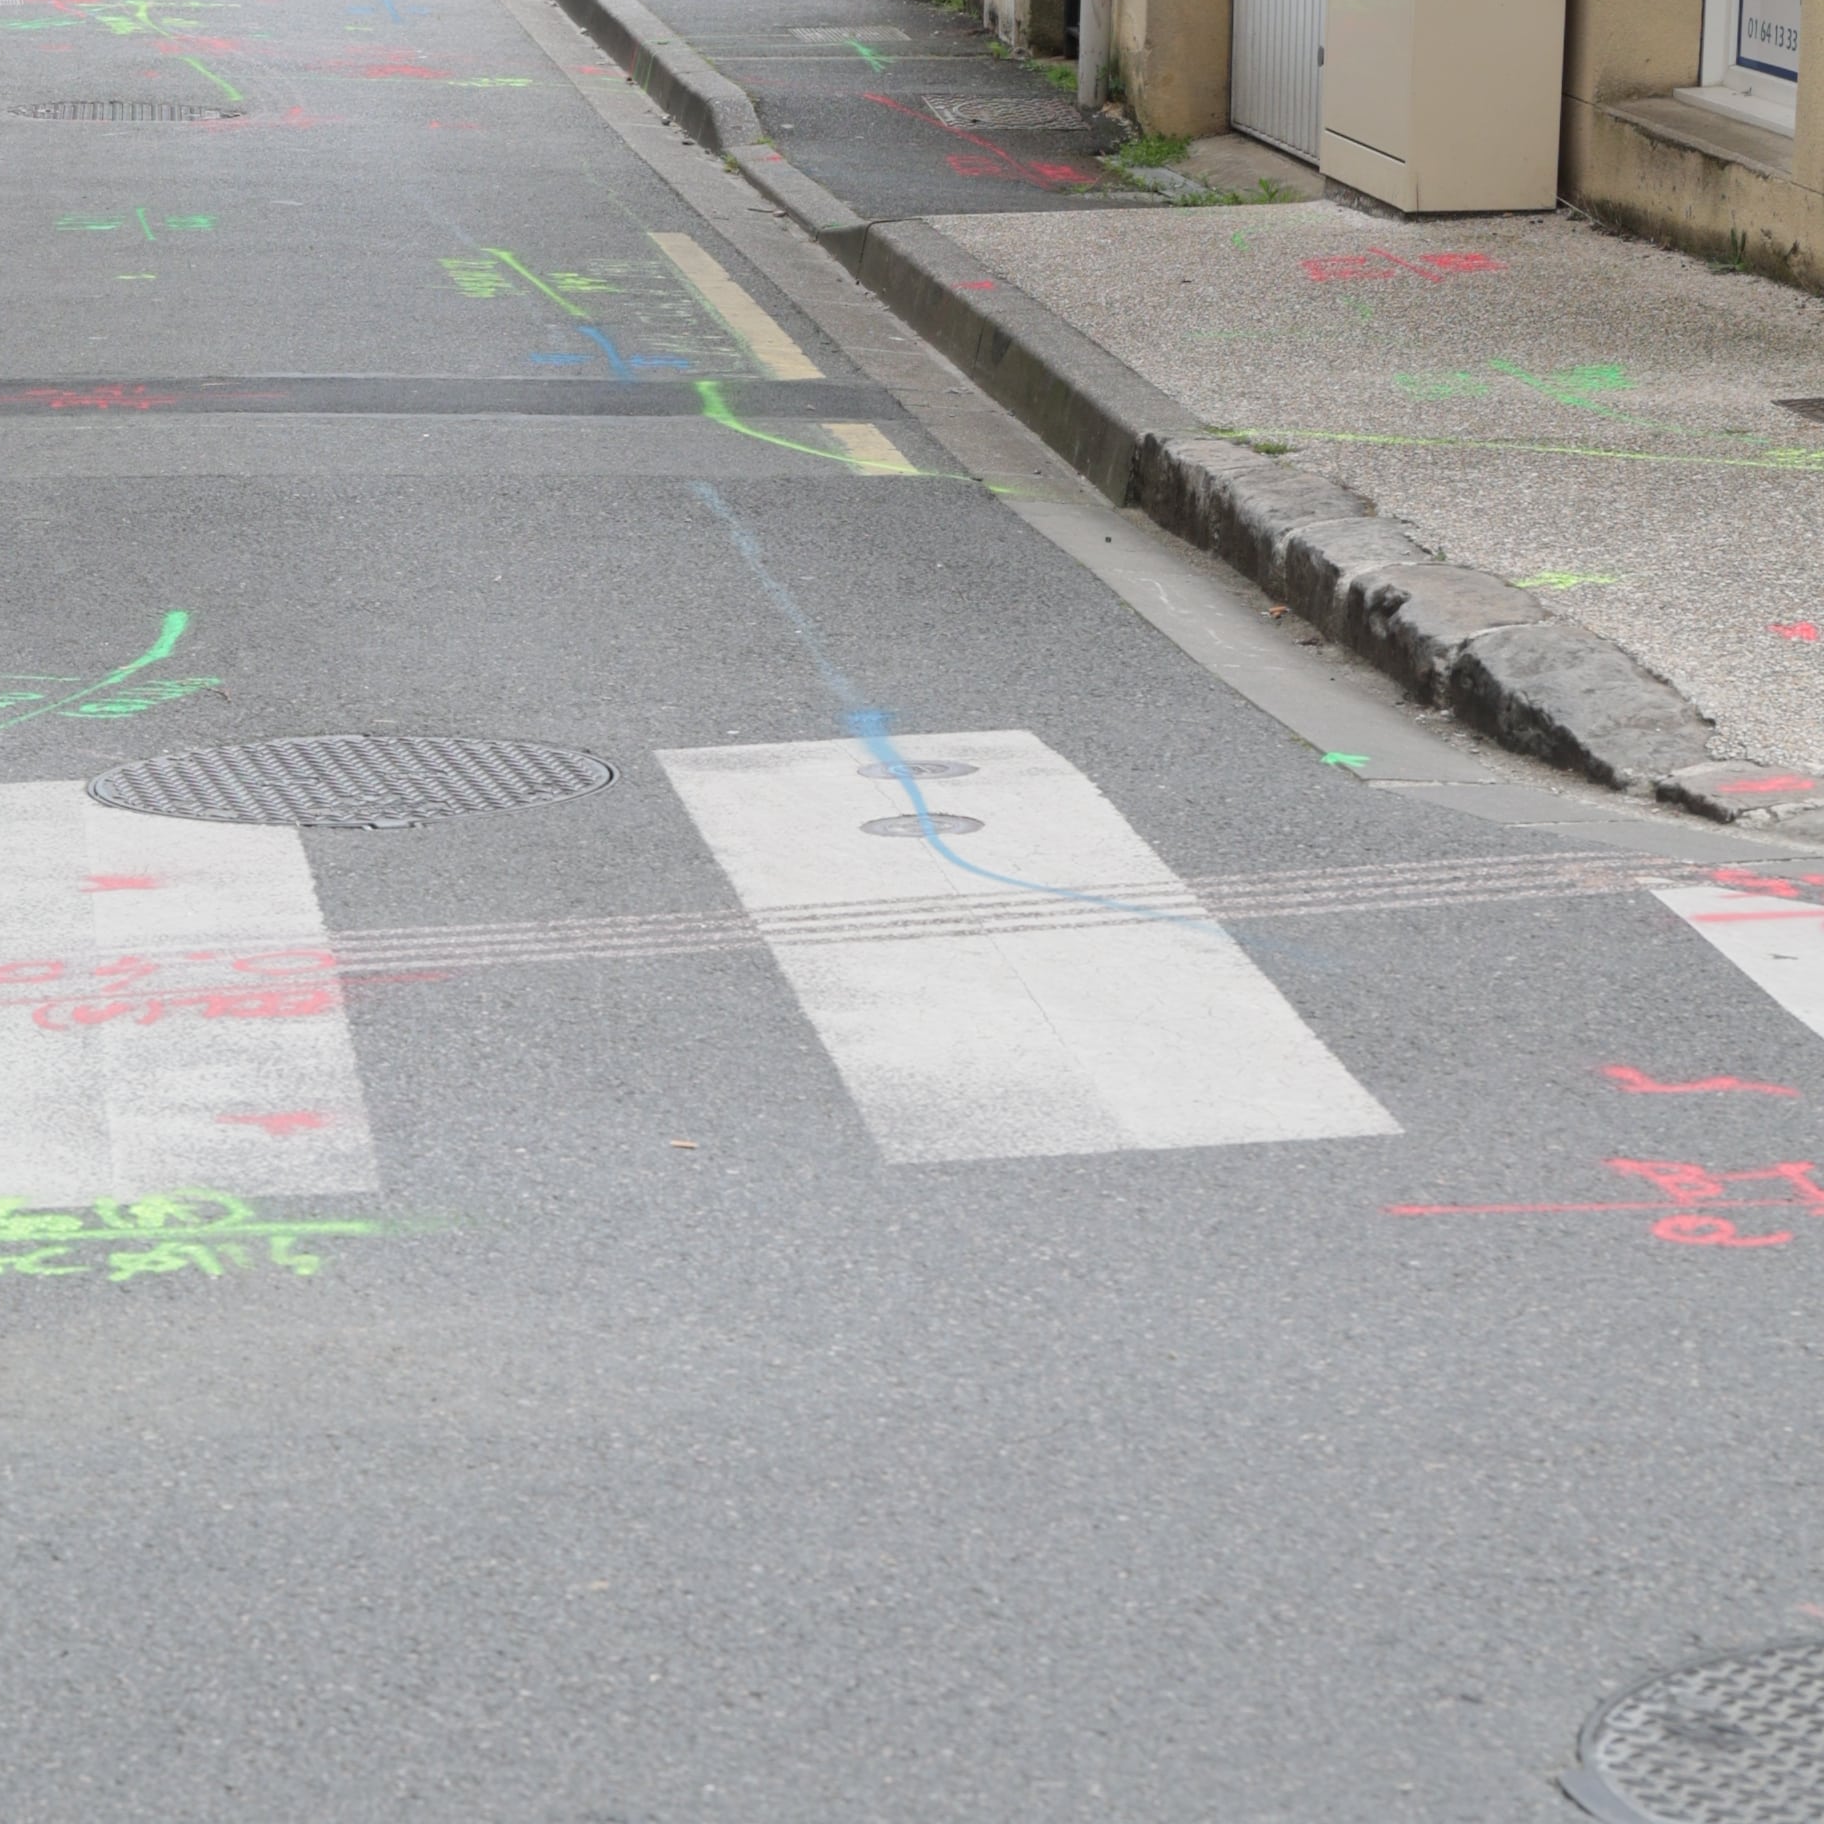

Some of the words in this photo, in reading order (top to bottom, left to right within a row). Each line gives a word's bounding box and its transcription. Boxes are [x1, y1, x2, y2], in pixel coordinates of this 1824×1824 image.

[1747, 16, 1759, 40] 01
[1760, 19, 1773, 44] 64
[1774, 24, 1785, 48] 13
